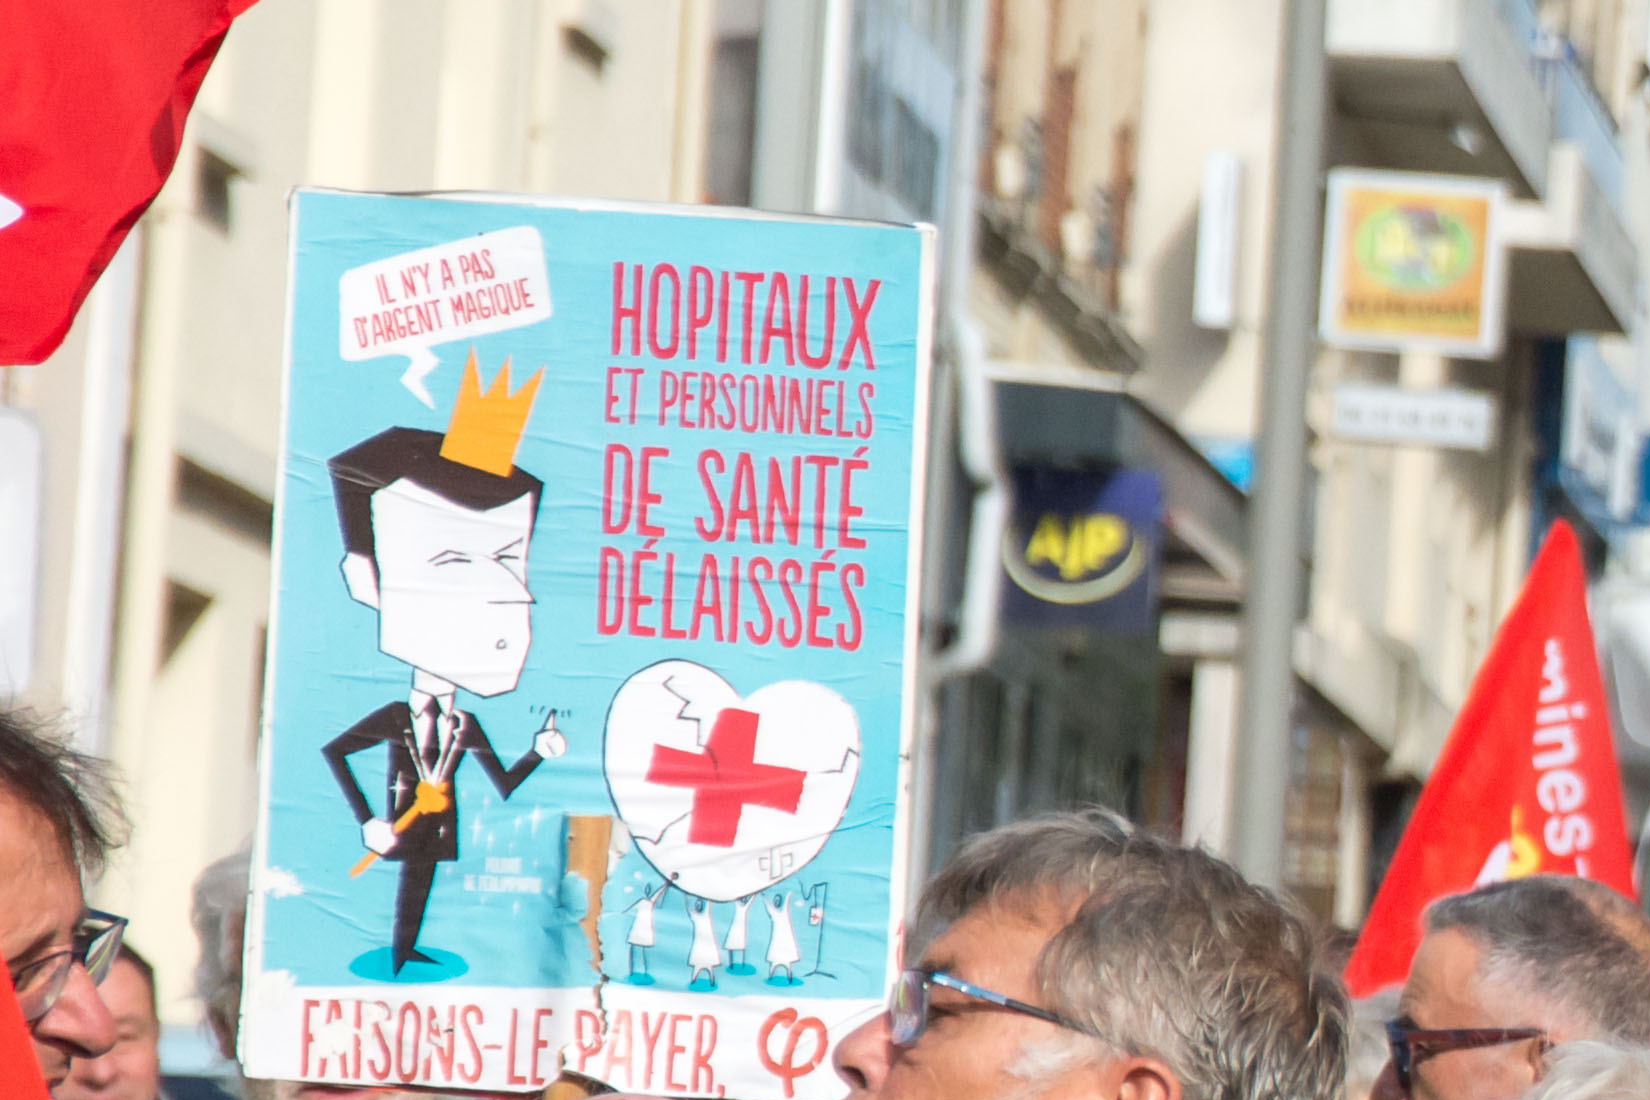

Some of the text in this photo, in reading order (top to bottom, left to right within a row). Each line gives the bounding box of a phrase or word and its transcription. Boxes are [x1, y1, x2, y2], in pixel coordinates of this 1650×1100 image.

[353, 277, 536, 349] D'ARGENT MAGIQUE
[375, 248, 495, 306] IL N'Y A PAS
[609, 260, 882, 372] HOPITAUX
[605, 365, 875, 440] ET PERSONNELS
[600, 442, 870, 550] DE SANTÉ
[596, 541, 865, 653] DÉLAISSÉS
[574, 1008, 727, 1099] PAYER,
